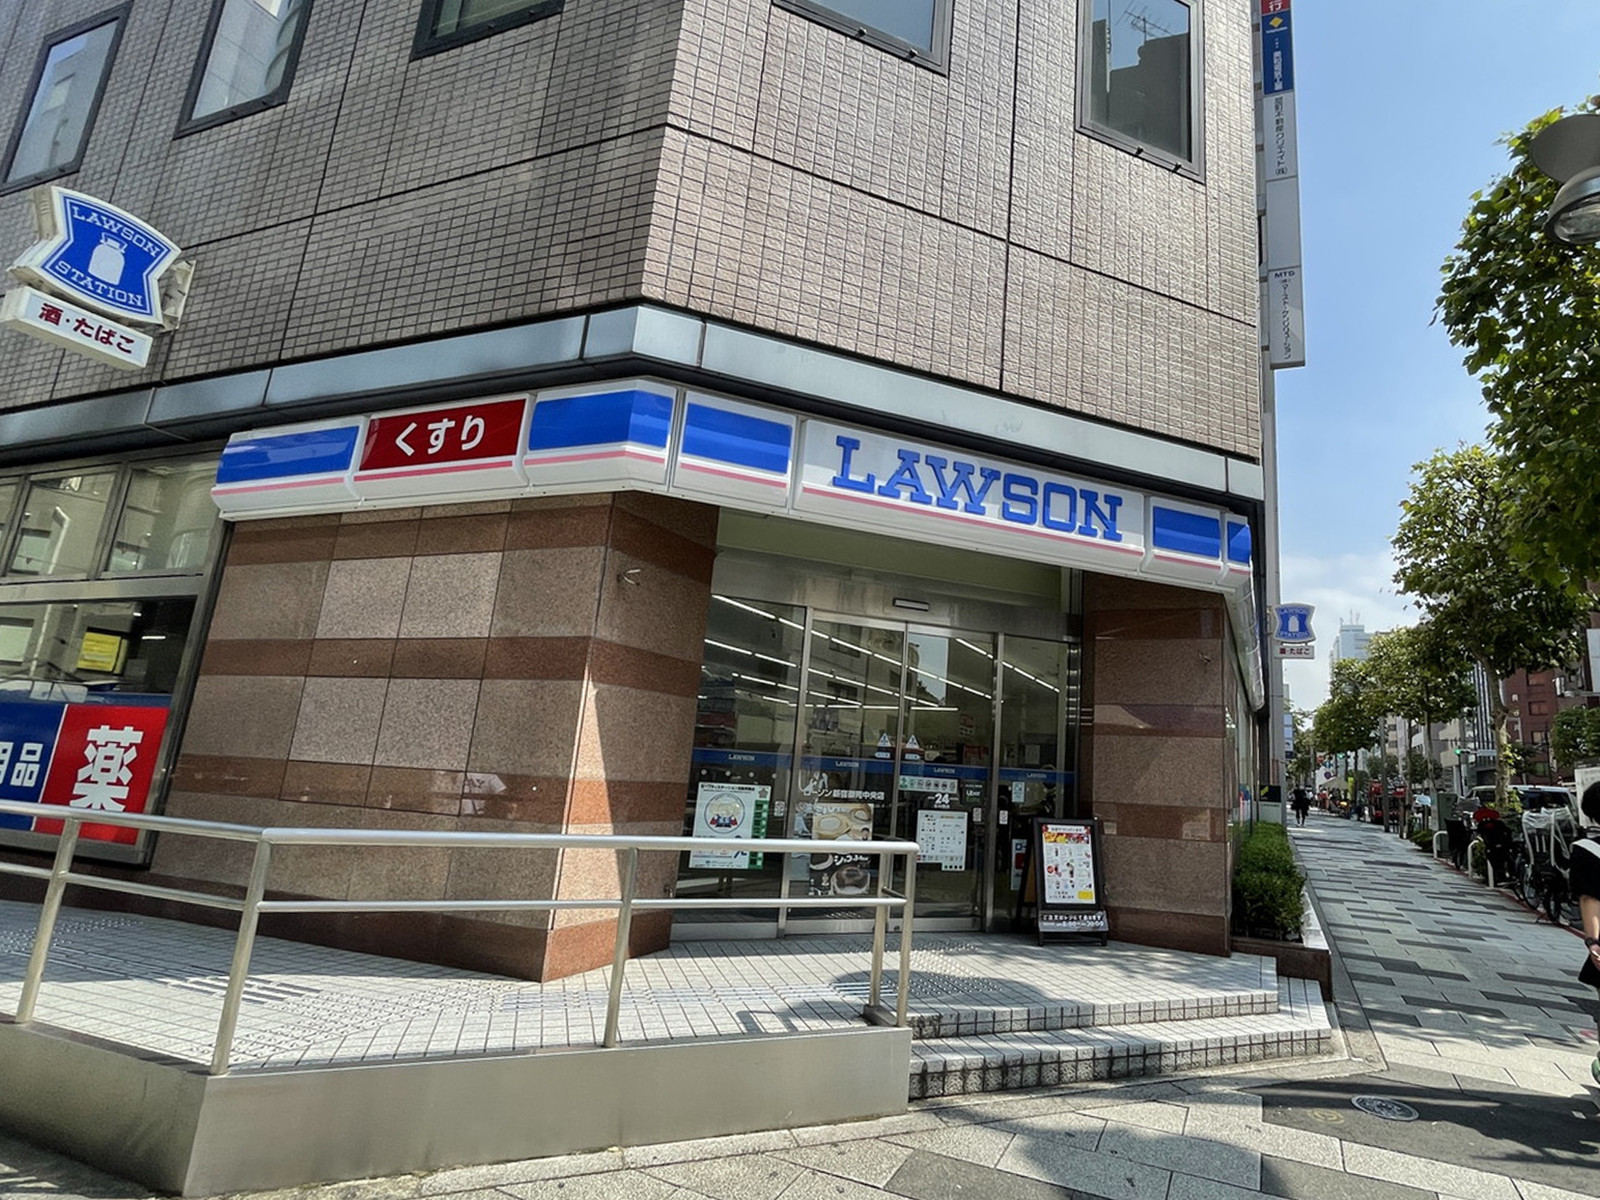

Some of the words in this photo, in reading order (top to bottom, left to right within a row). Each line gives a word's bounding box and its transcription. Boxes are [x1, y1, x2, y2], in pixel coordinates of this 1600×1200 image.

[71, 205, 161, 258] LAWSON
[54, 260, 144, 307] STATION
[1274, 270, 1295, 278] MTS
[38, 302, 136, 354] 酒・たばこ
[394, 414, 485, 457] くすり
[832, 435, 1123, 542] LAWSON
[69, 724, 144, 813] 薬
[934, 793, 951, 805] 24
